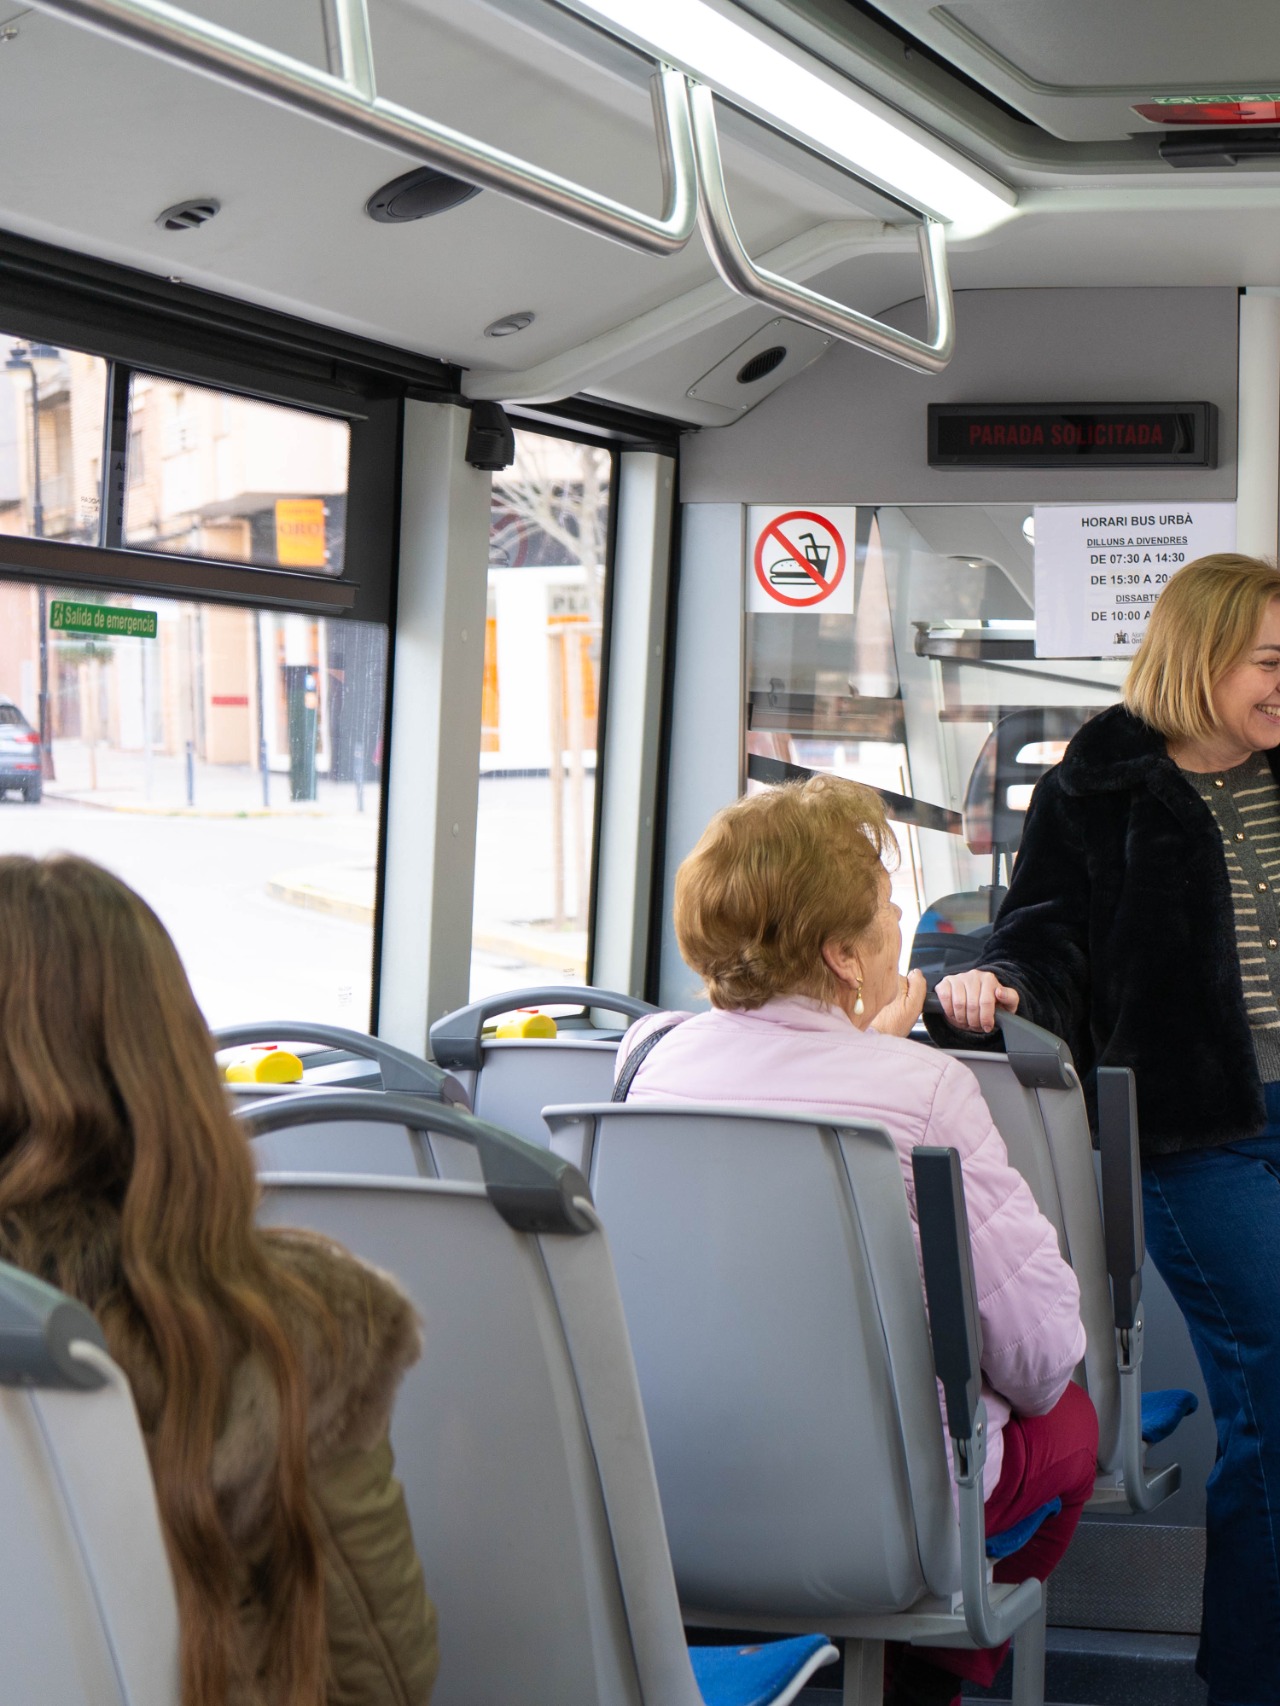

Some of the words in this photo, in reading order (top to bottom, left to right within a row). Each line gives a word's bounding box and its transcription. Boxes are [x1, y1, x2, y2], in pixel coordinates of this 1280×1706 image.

[969, 425, 1044, 445] PARADA
[1051, 424, 1164, 445] SOLICITADA
[1081, 516, 1127, 527] HORARI
[1131, 515, 1156, 526] BUS
[1159, 512, 1193, 525] URBÀ
[1087, 538, 1125, 546] DILLUNS
[1136, 536, 1188, 545] DIVENDRES
[1090, 554, 1106, 564] DE
[1110, 553, 1140, 564] 07:30
[1143, 553, 1151, 563] A
[1155, 552, 1185, 562] 14:30
[1091, 575, 1106, 585] DE
[1111, 574, 1140, 584] 15:30
[1143, 573, 1152, 584] A
[65, 606, 92, 627] Salida
[94, 610, 105, 628] de
[106, 614, 155, 634] emergencia
[1091, 611, 1107, 621] DE
[1111, 610, 1141, 621] 10:00
